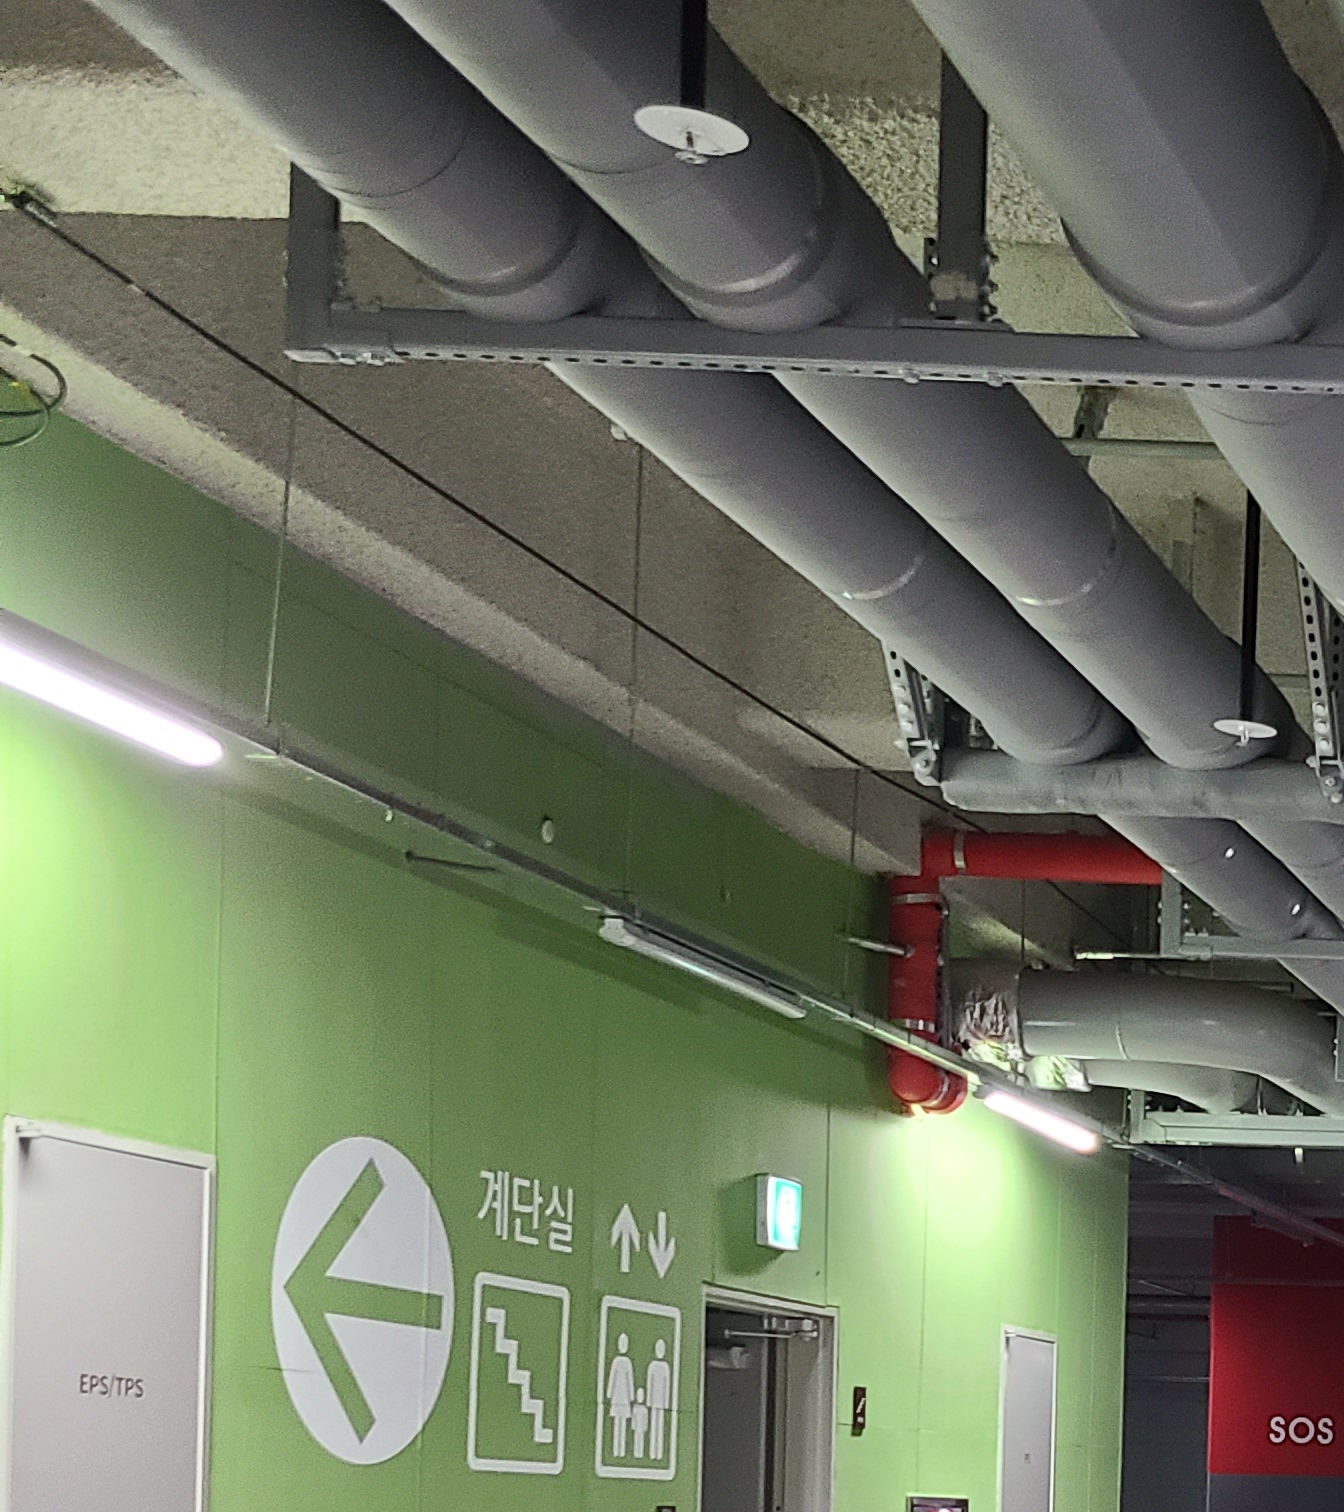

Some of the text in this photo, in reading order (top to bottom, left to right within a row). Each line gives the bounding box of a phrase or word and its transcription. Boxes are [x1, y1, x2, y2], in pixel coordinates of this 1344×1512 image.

[477, 1170, 574, 1254] 계단실
[79, 1373, 144, 1399] EPS/TPS
[1268, 1415, 1334, 1445] SOS
